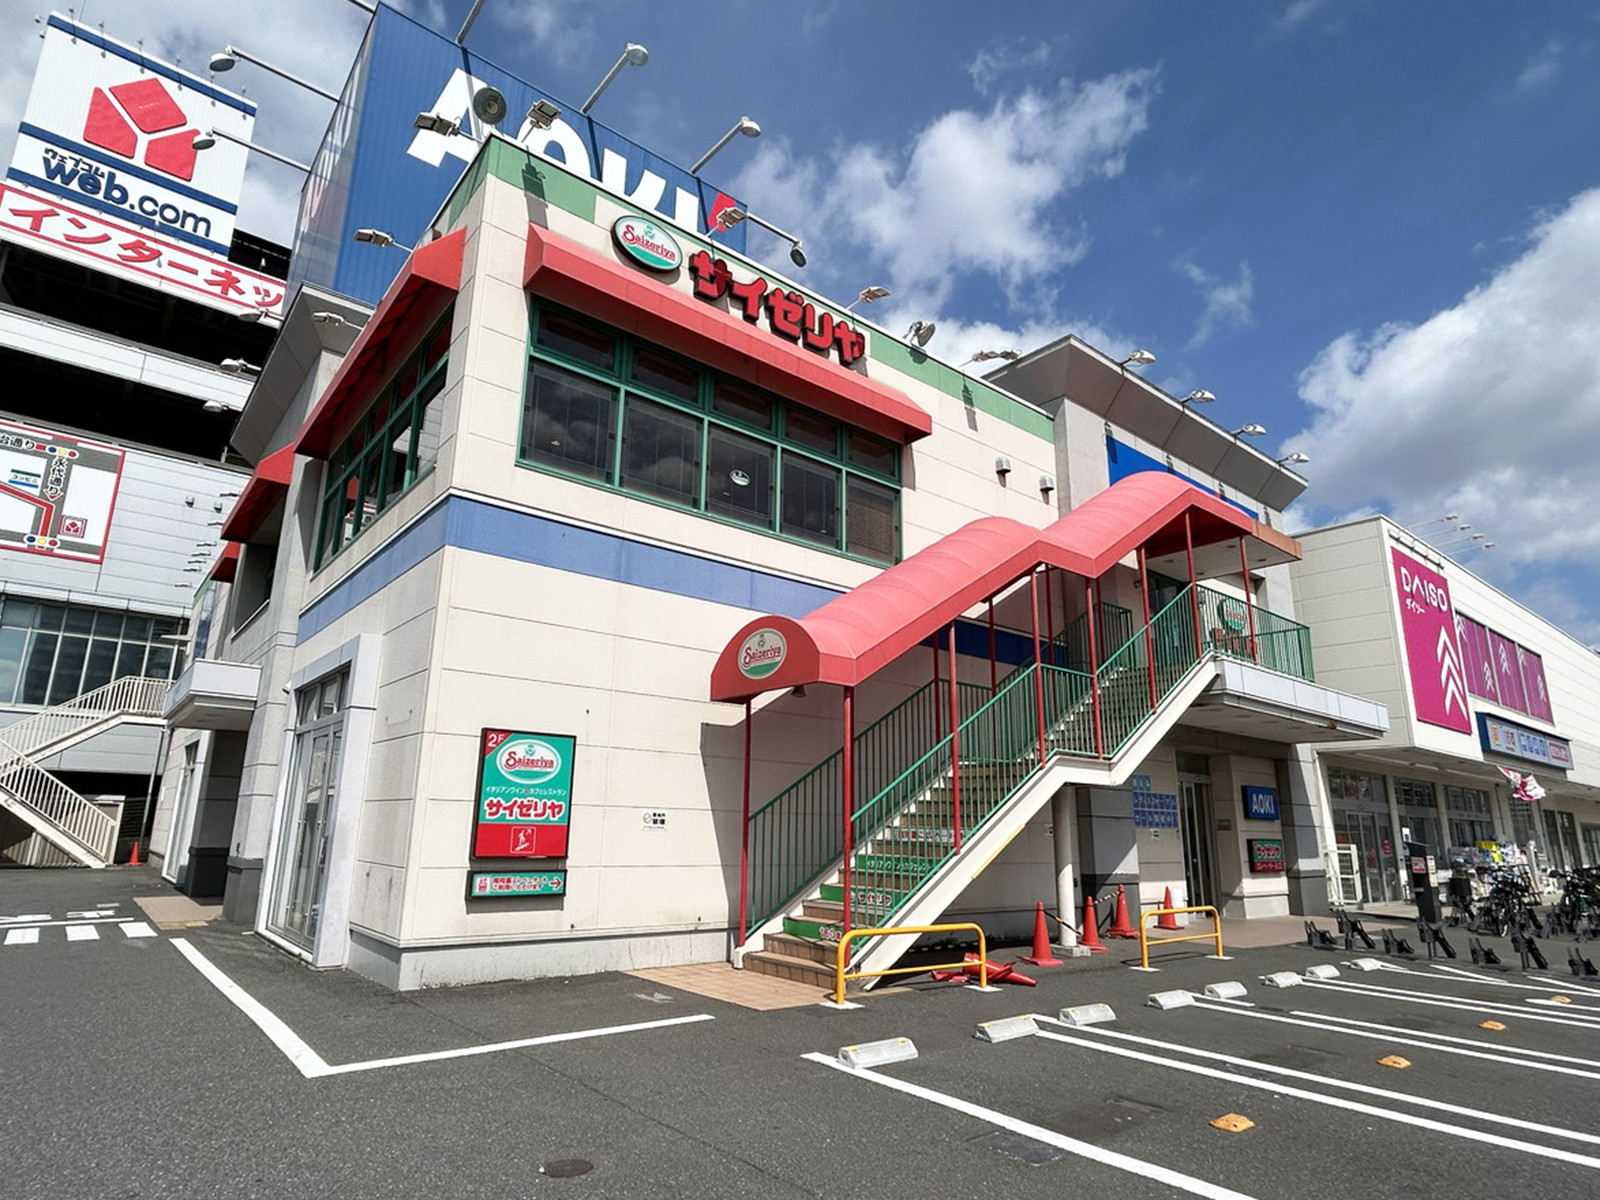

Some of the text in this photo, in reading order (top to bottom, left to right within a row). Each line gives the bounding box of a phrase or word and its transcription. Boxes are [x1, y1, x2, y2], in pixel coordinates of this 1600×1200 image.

[42, 156, 212, 238] web.com
[621, 224, 676, 262] Saizeriya
[690, 250, 865, 366] サイゼリヤ
[13, 474, 38, 484] コンビニ
[1400, 566, 1448, 612] DAISO
[743, 646, 781, 668] Saizeriya
[487, 733, 505, 748] 2F
[504, 750, 555, 771] Saizeriya
[485, 796, 564, 821] サイゼリヤ
[1252, 793, 1275, 814] AOKI
